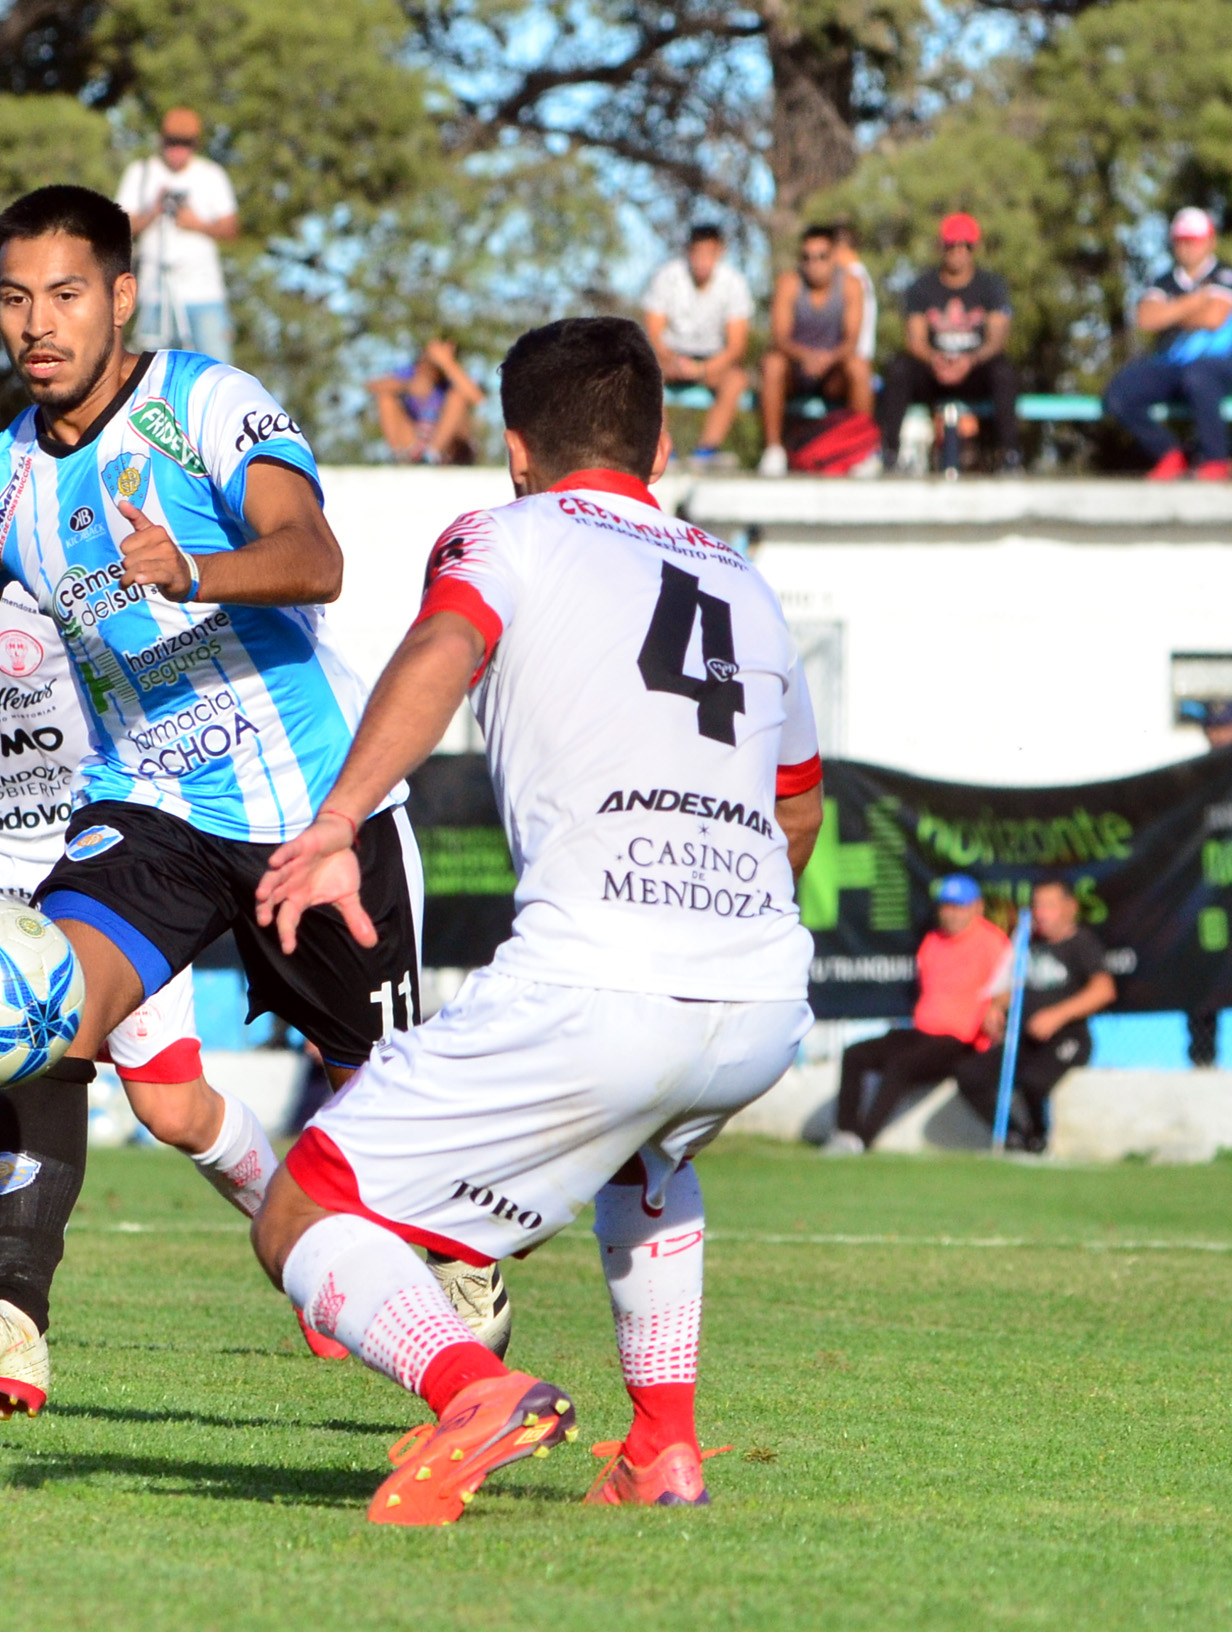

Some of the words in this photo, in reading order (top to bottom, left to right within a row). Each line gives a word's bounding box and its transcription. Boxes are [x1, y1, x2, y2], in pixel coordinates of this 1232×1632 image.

[124, 611, 230, 673] horizonte
[138, 638, 222, 691] seguros
[637, 560, 746, 748] 4
[128, 690, 236, 753] farmacia
[138, 711, 261, 777] OCHOA
[596, 788, 774, 840] ANDESMAR
[628, 836, 759, 883] CASINO
[692, 870, 706, 881] DE
[601, 869, 783, 919] MENDOZA
[370, 970, 414, 1038] 11
[450, 1179, 543, 1230] TORO
